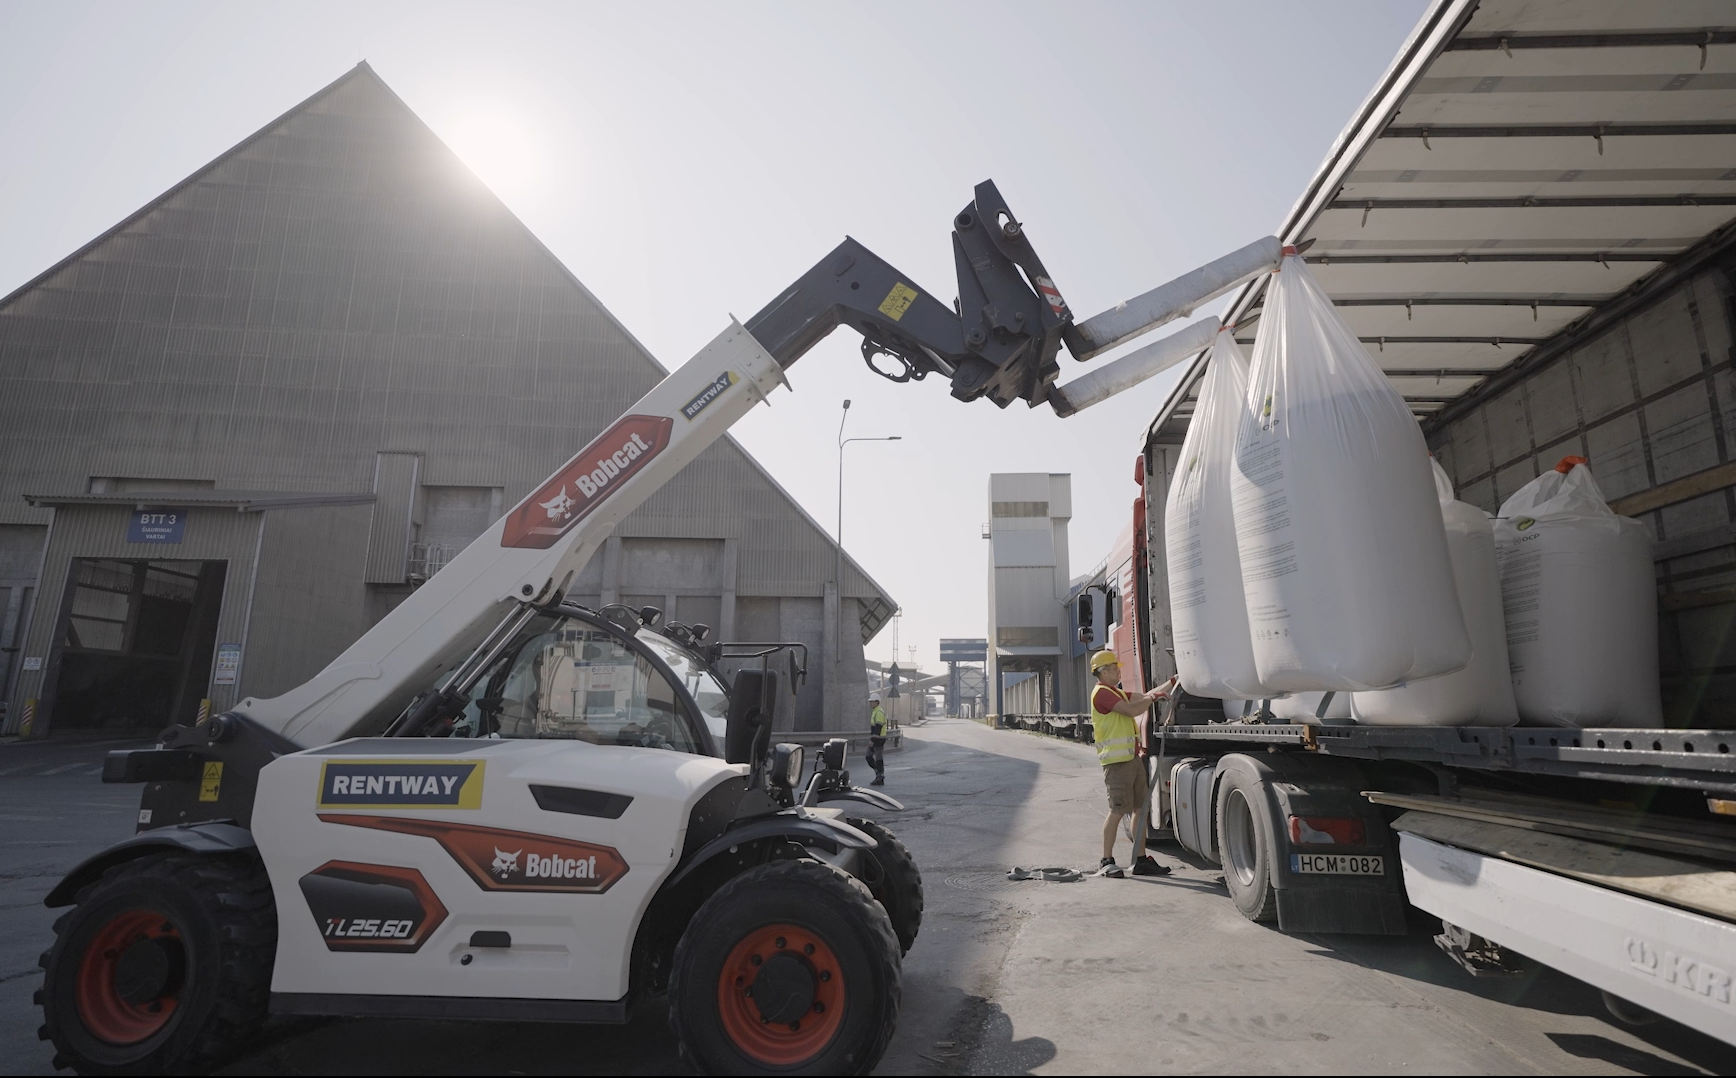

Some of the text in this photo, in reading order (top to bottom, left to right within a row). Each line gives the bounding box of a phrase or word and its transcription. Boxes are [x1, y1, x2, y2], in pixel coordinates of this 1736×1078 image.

[686, 377, 728, 416] RENTWAY
[575, 432, 649, 499] Bobcat
[140, 513, 177, 525] BTT 3
[1521, 533, 1540, 542] OCP
[332, 775, 459, 796] RENTWAY
[525, 853, 597, 879] Bobcat
[1301, 856, 1381, 874] HCM 082
[1664, 951, 1736, 1005] KR
